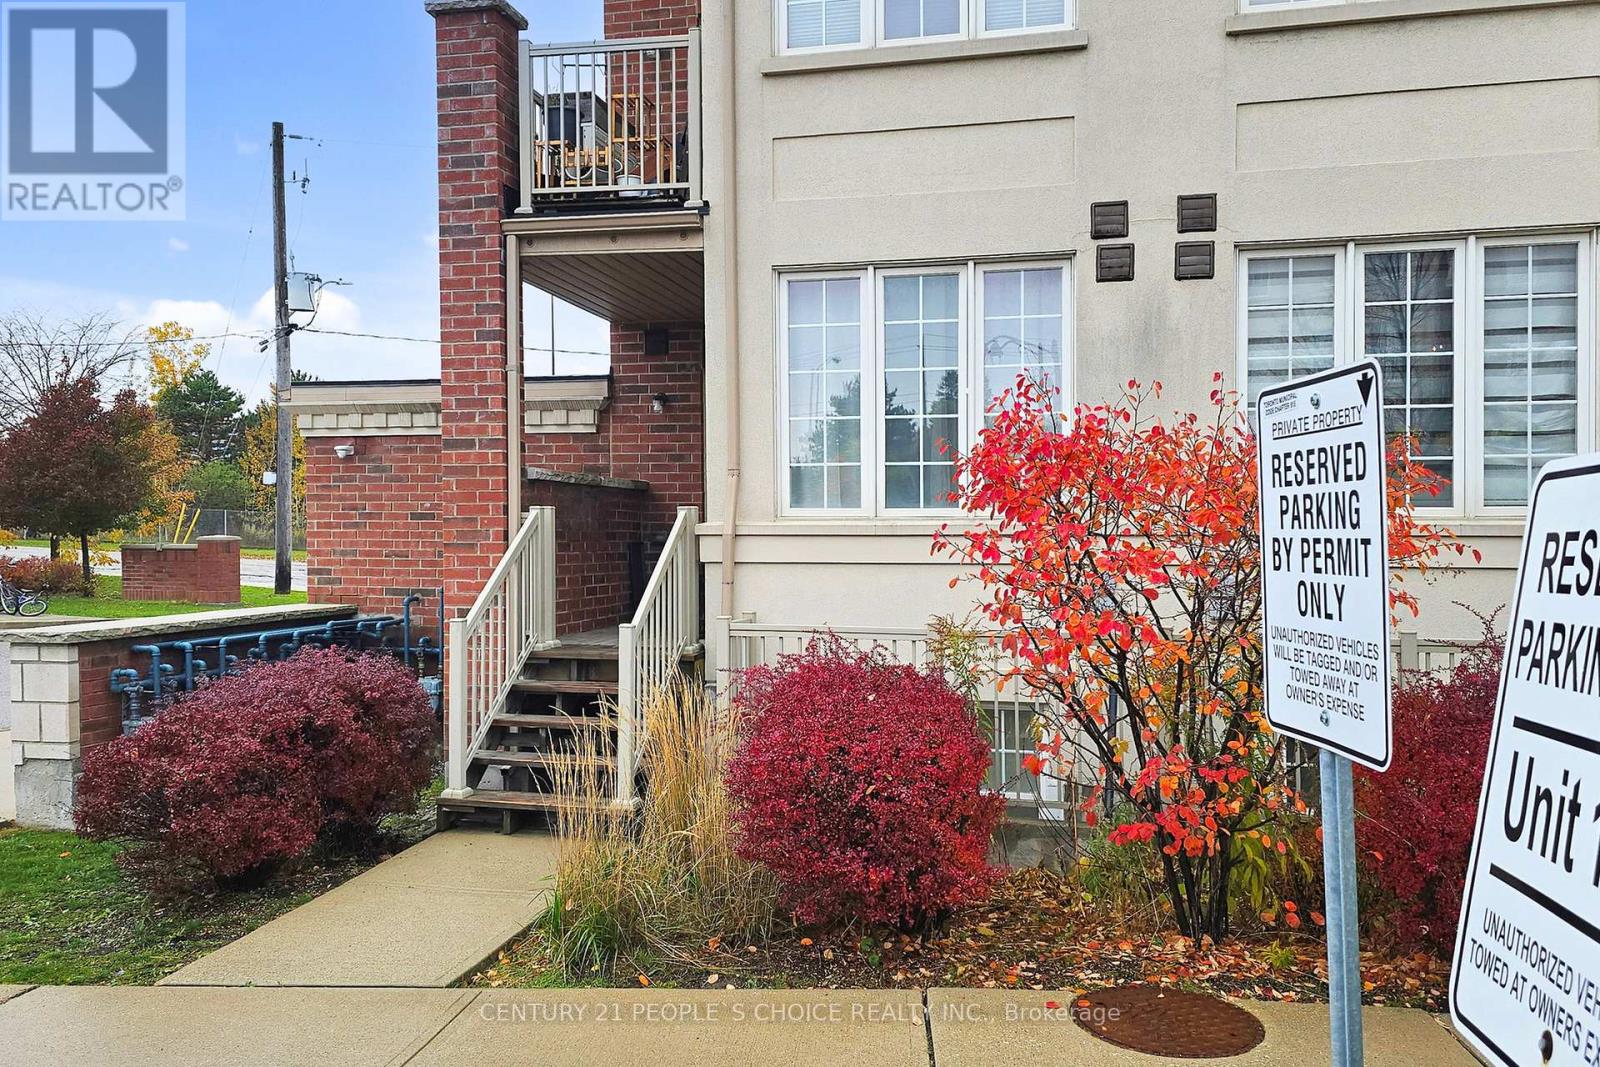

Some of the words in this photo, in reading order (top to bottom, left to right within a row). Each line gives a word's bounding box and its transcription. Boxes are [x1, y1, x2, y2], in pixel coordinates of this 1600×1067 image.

[1272, 416, 1309, 437] PRIVATE
[1313, 405, 1363, 428] PROPERTY
[1272, 441, 1367, 488] RESERVED
[1280, 490, 1360, 530] PARKING
[1272, 537, 1293, 572] BY
[1301, 537, 1372, 578] PERMIT
[1537, 529, 1600, 596] RES
[1297, 580, 1345, 622] ONLY
[1271, 625, 1334, 651] UNAUTHORIZED
[1336, 636, 1379, 661] VEHICLES
[1273, 644, 1292, 662] WILL
[1293, 648, 1304, 664] BE
[1307, 650, 1341, 673] TAGGED
[1343, 660, 1378, 682] AND/OR
[1290, 666, 1320, 687] TOWED
[1322, 675, 1348, 693] AWAY
[1348, 681, 1359, 698] AT
[1286, 684, 1325, 709] OWNER'S
[1326, 697, 1365, 722] EXPENSE
[1503, 750, 1581, 874] Unit
[1483, 907, 1573, 995] UNAUTHORIZED
[1470, 938, 1508, 988] TOWED
[1510, 971, 1528, 1004] AT
[1529, 984, 1583, 1052] OWNERS
